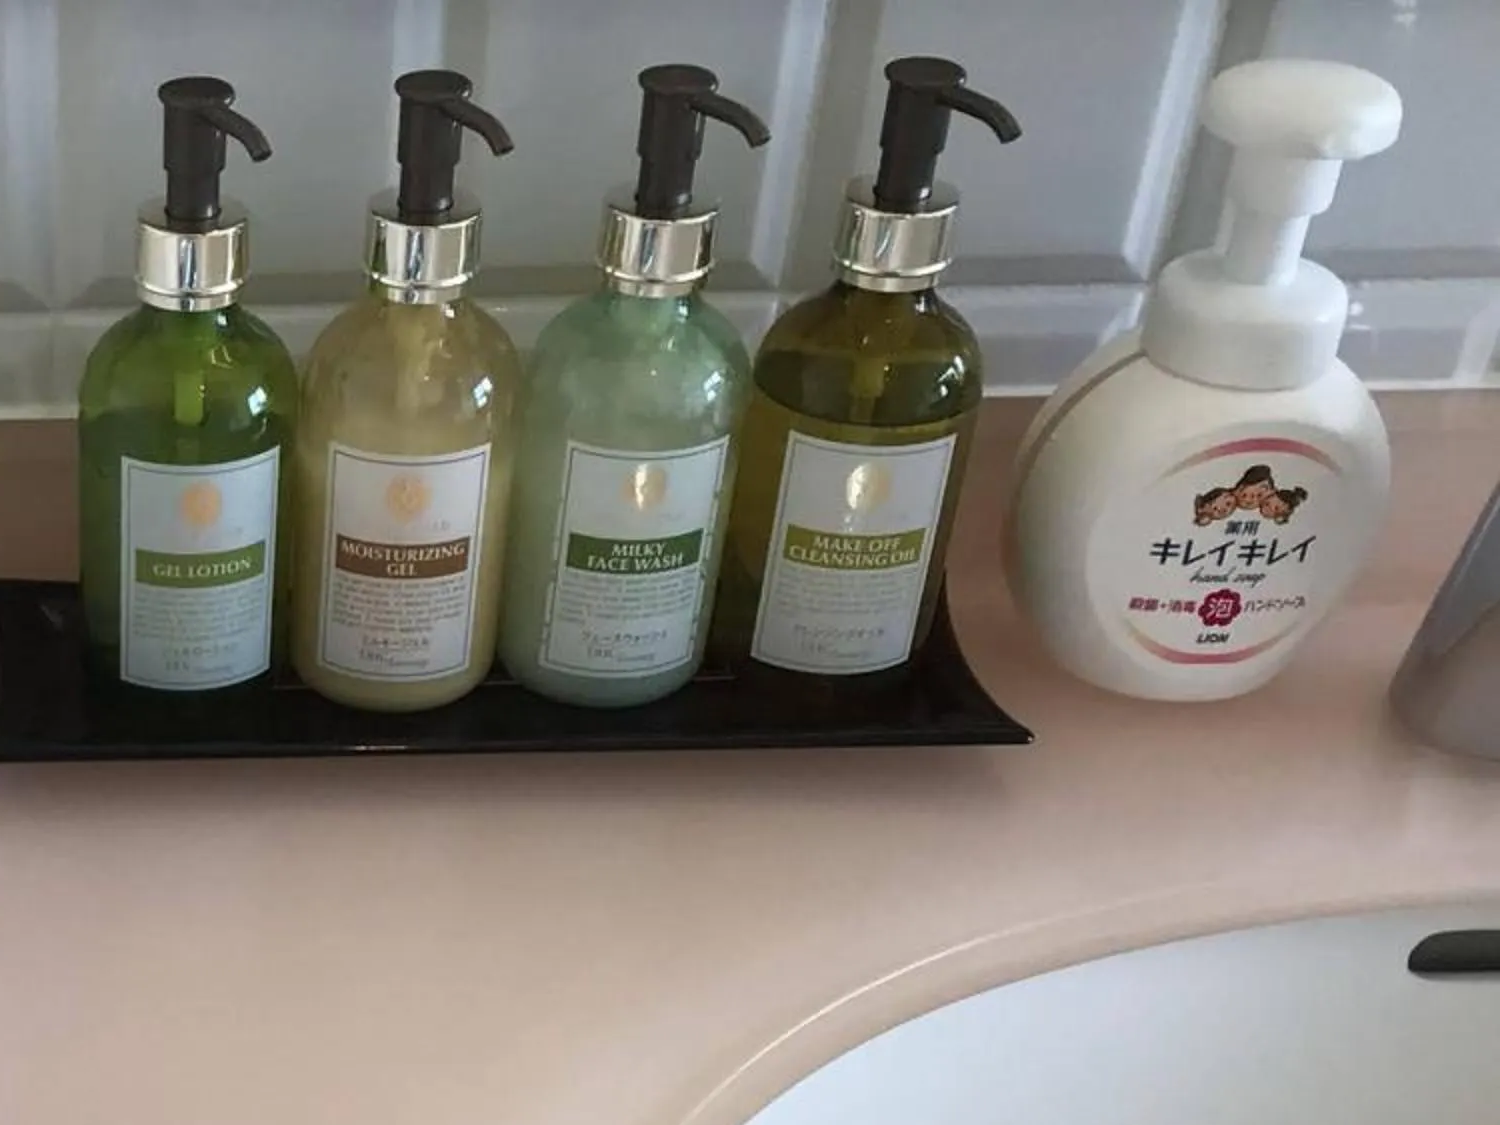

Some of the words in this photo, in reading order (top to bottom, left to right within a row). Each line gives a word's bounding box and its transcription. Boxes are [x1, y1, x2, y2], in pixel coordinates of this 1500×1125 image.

[1224, 520, 1261, 535] 薬用
[341, 539, 466, 562] MOISTURIZING
[611, 542, 666, 557] MILKY
[813, 535, 862, 551] MAKE
[869, 536, 901, 553] OFF
[1149, 535, 1317, 566] キレイキレイ
[587, 554, 630, 571] FACE
[634, 552, 684, 571] WASH
[788, 545, 887, 568] CLEANSING
[890, 548, 916, 564] OIL
[151, 563, 182, 578] GEL
[187, 556, 252, 579] LOTION
[386, 563, 418, 577] GEL
[1189, 566, 1236, 583] hand
[1196, 632, 1231, 644] LION
